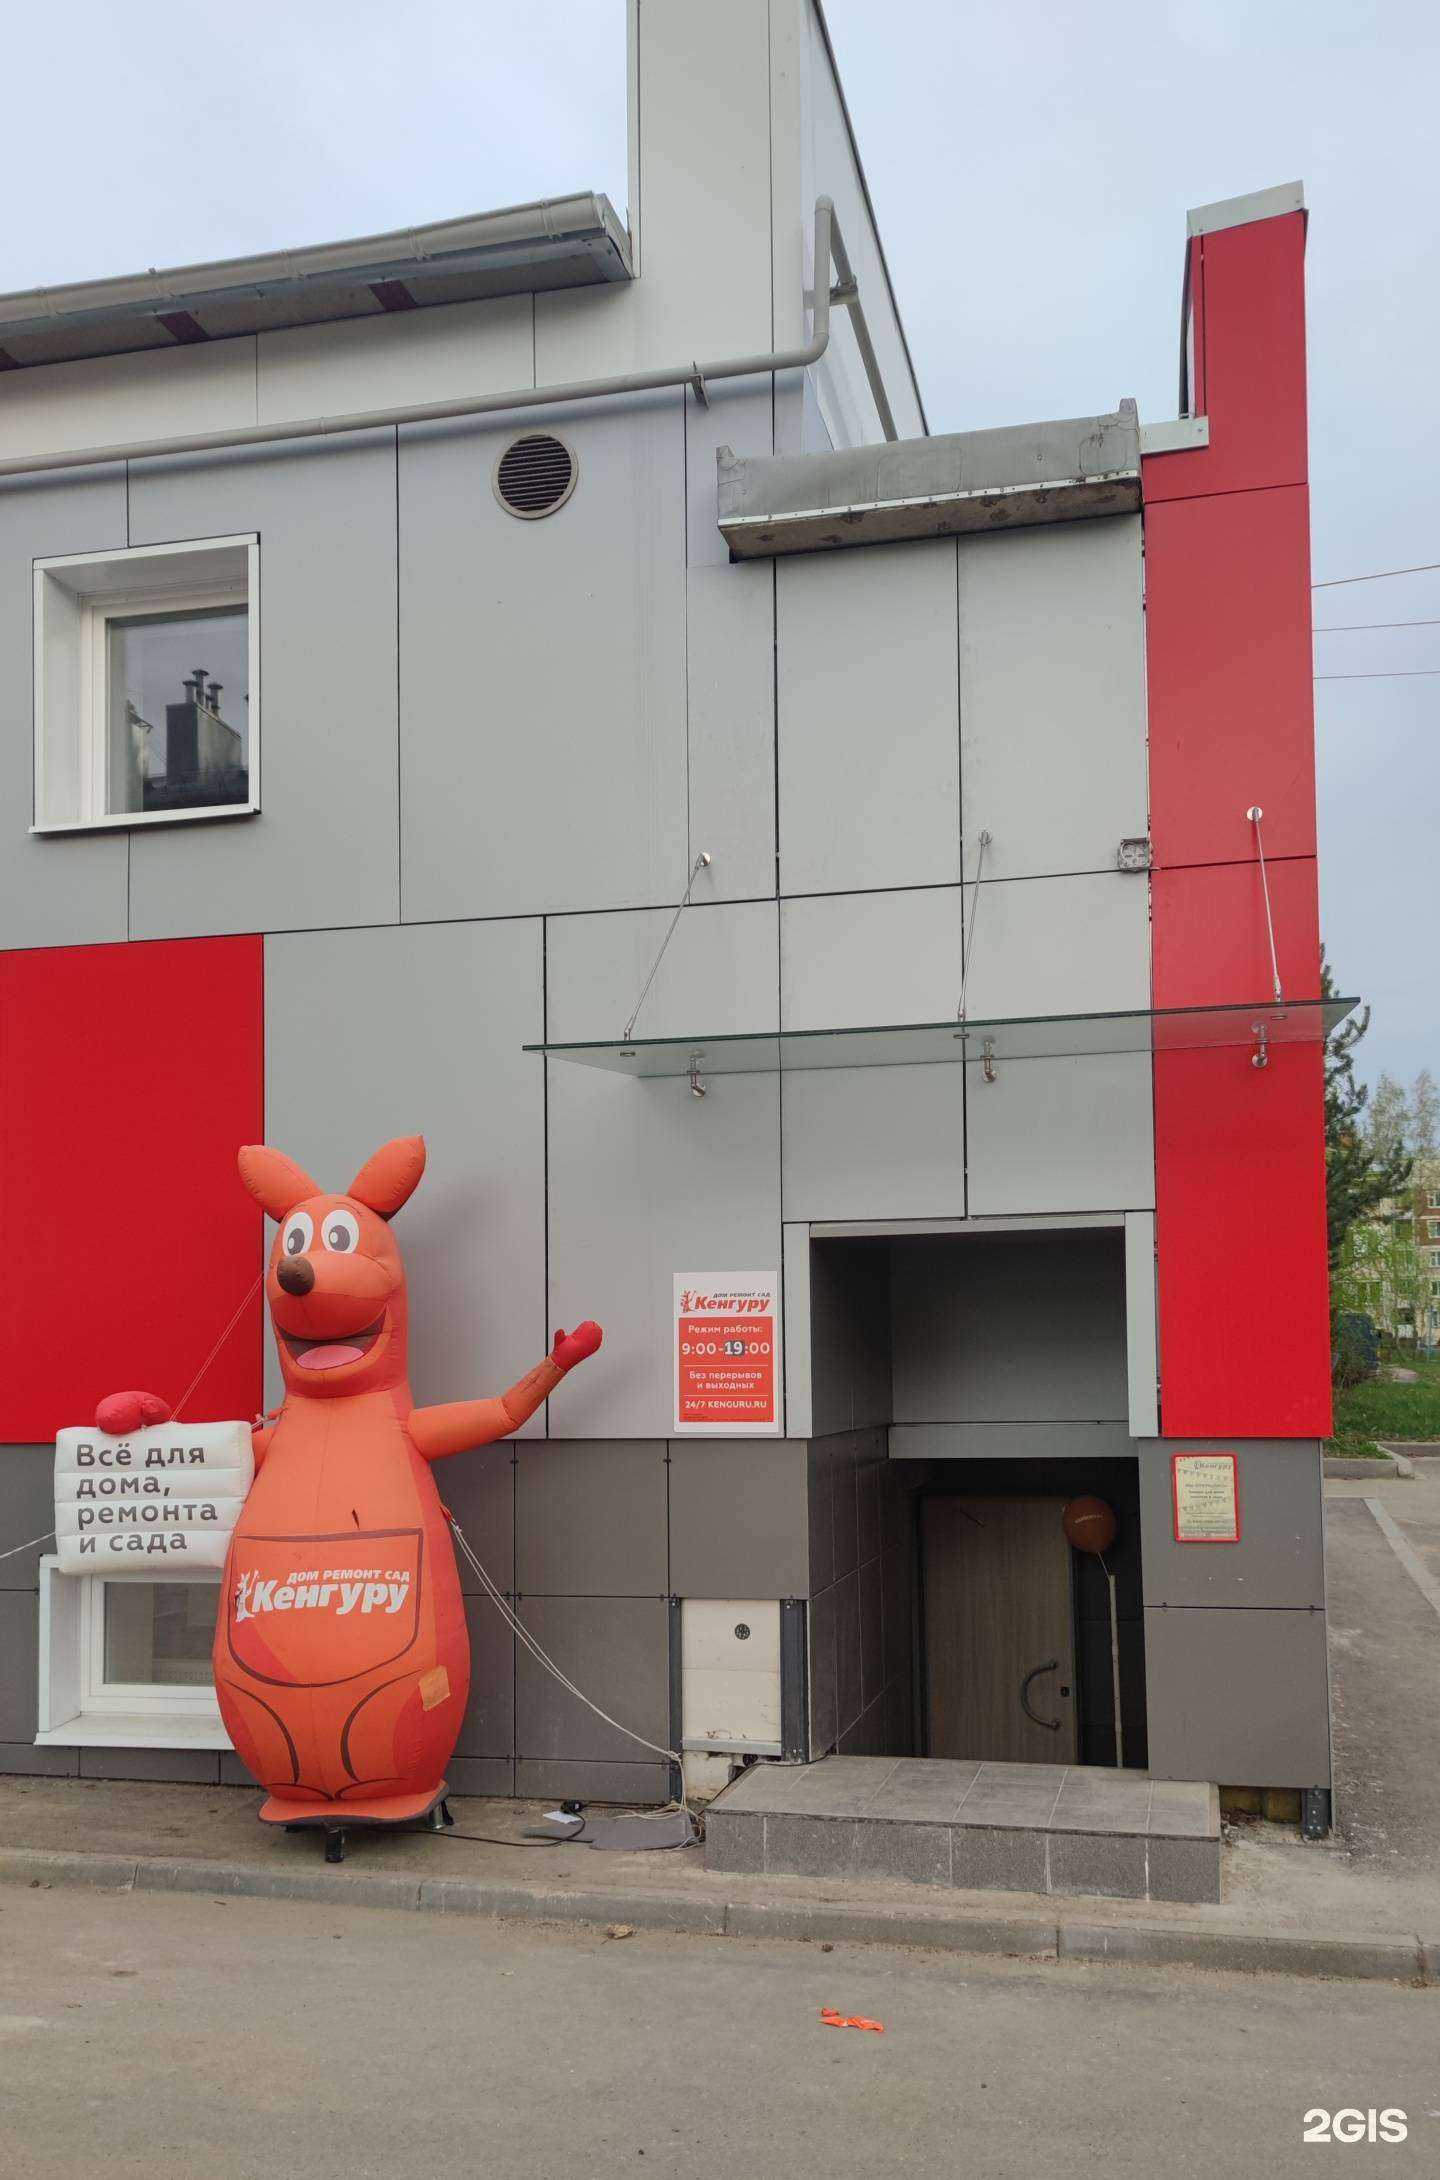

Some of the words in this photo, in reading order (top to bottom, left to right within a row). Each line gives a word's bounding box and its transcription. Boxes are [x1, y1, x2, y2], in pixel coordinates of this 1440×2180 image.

[695, 1296, 770, 1313] Кенгуру
[688, 1325, 721, 1333] Режим
[724, 1324, 763, 1334] работы:
[689, 1371, 706, 1379] Без
[709, 1372, 762, 1380] перерывов
[685, 1400, 706, 1409] 24/7
[708, 1400, 767, 1408] KENGURU.RU
[76, 1443, 132, 1466] Всё
[145, 1446, 205, 1468] для
[76, 1476, 171, 1498] дома,
[78, 1503, 218, 1530] ремонта
[80, 1536, 96, 1553] и
[109, 1532, 188, 1553] сада
[287, 1571, 319, 1584] ДОМ
[323, 1570, 381, 1580] РЕМОНТ
[385, 1571, 410, 1582] САД
[252, 1579, 409, 1615] Кенгуру
